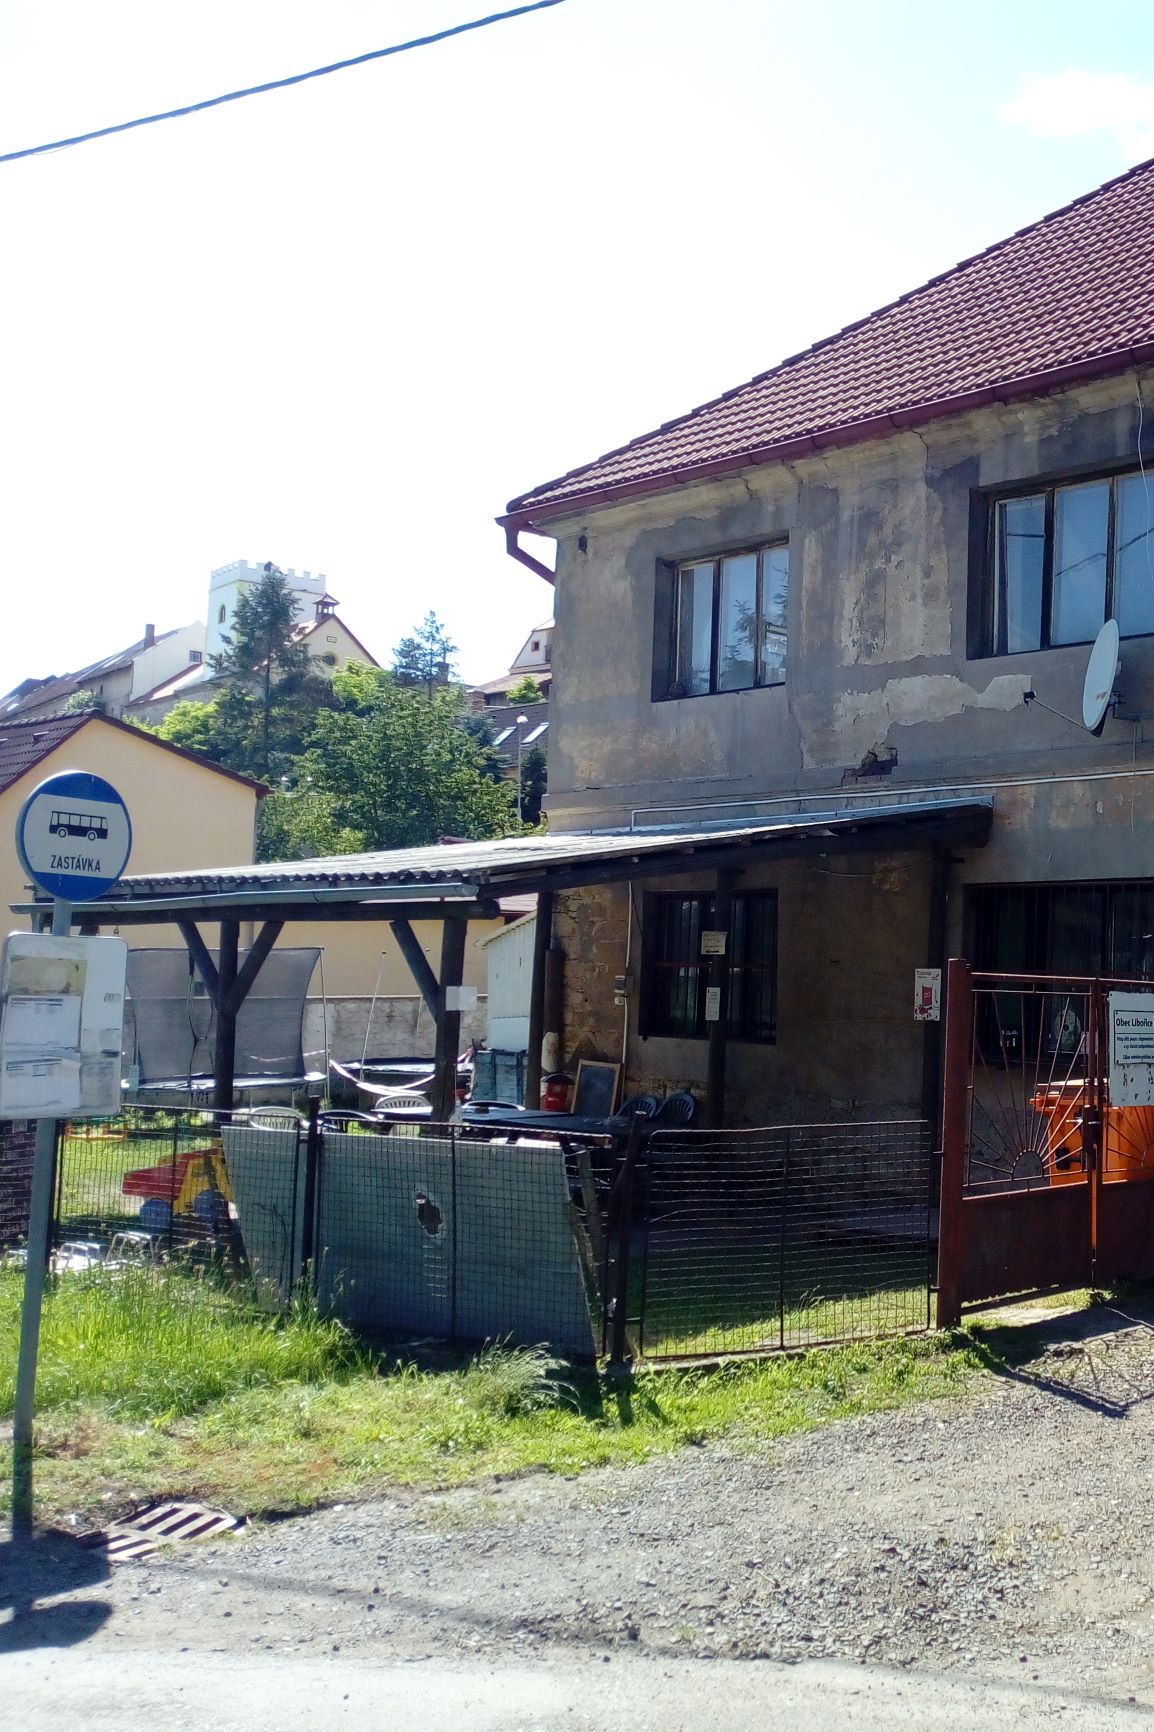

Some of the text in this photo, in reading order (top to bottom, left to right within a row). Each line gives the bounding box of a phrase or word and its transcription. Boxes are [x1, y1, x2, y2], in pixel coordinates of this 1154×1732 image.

[50, 854, 101, 872] ZASTÁVKA
[1116, 1018, 1153, 1027] Obec Libořice
